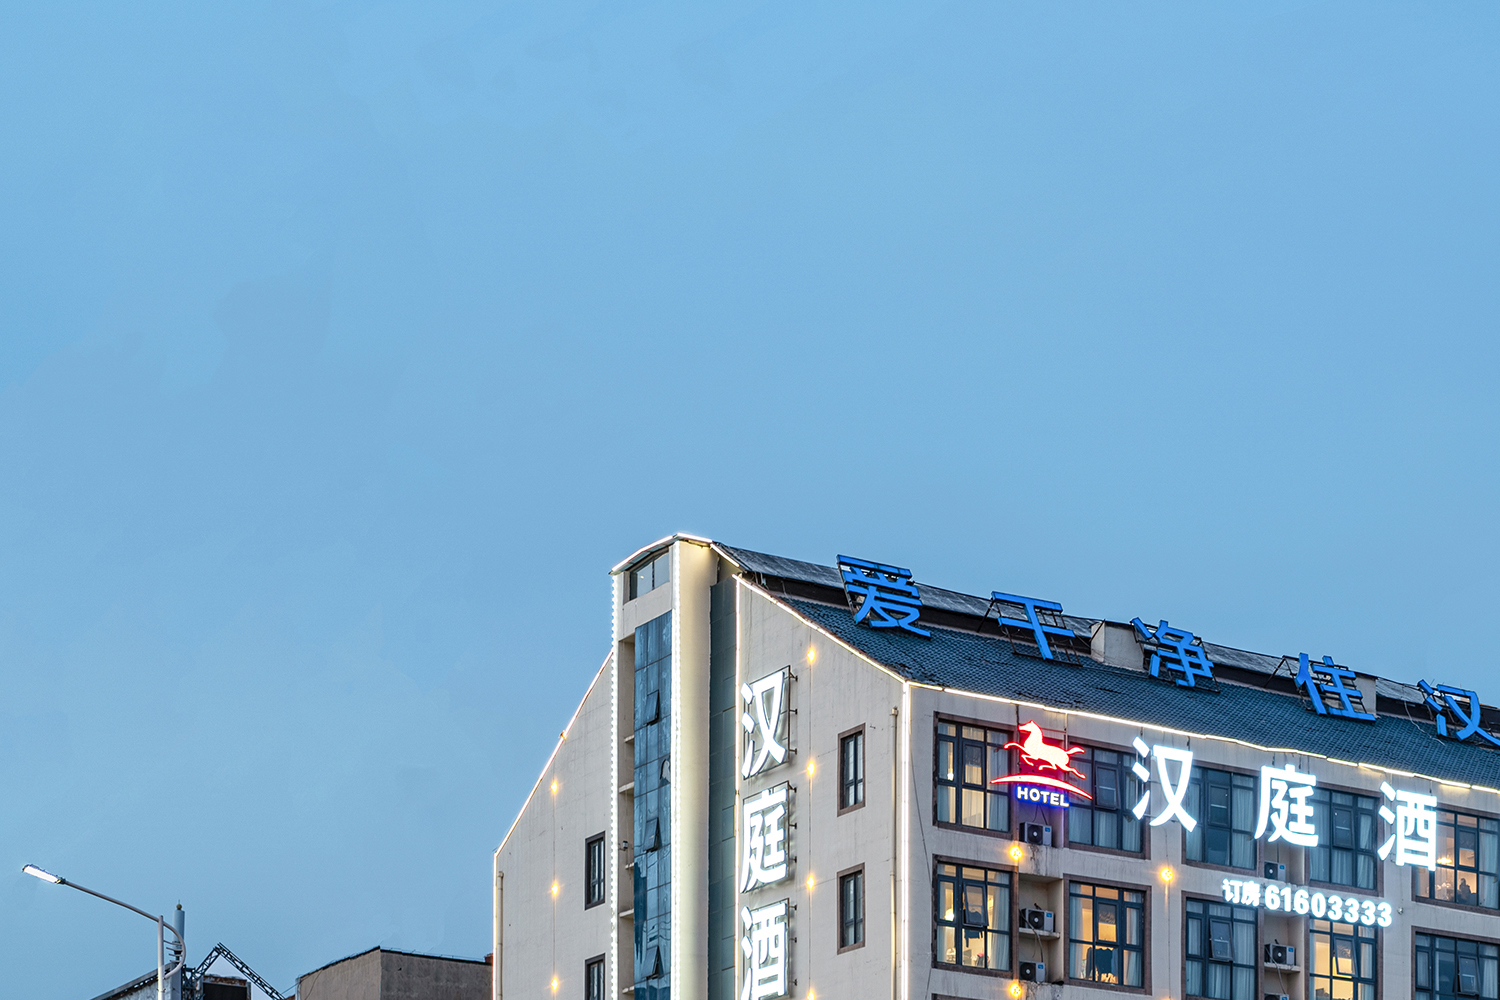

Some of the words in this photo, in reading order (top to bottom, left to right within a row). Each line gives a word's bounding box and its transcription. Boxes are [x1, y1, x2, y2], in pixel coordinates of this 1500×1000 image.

[1016, 786, 1070, 807] HOTEL
[1222, 878, 1261, 907] 订房
[1264, 884, 1392, 928] 61603333
